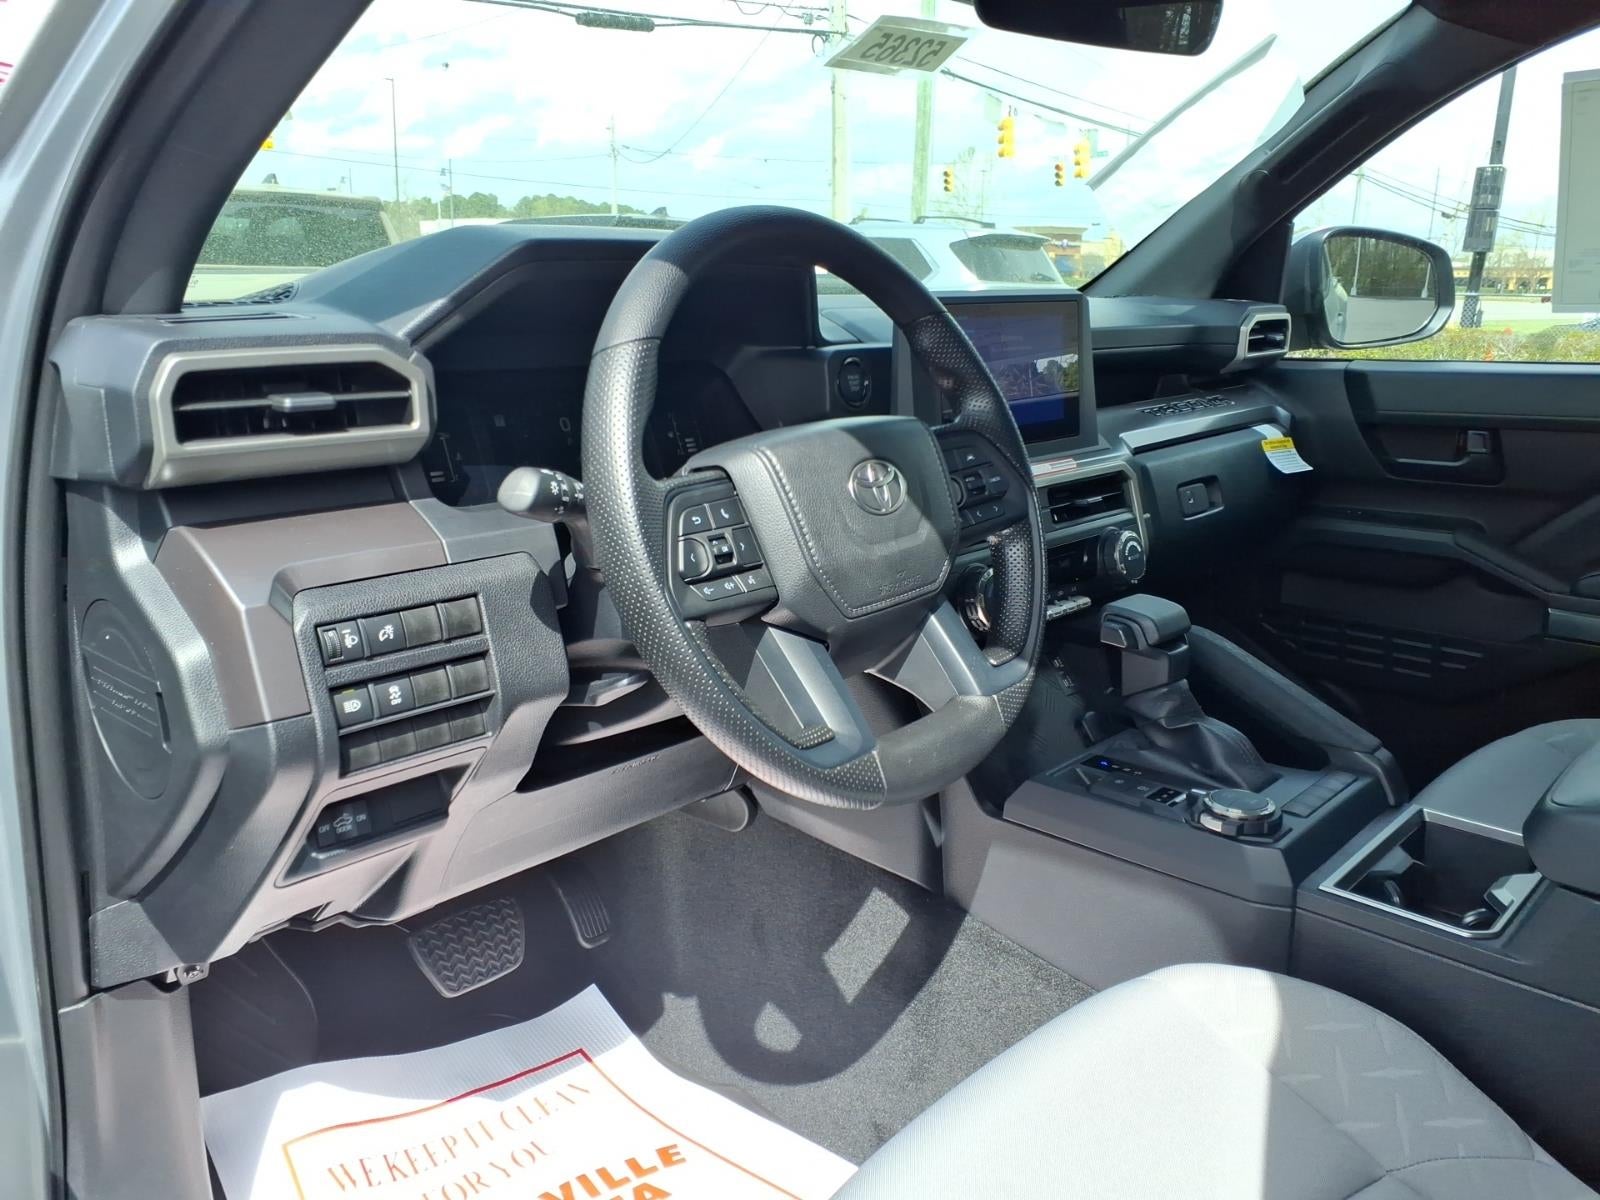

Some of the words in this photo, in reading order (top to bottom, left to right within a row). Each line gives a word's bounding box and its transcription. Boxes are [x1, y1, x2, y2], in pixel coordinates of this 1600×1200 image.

[327, 1158, 382, 1192] WE
[382, 1135, 457, 1182] KEEP
[489, 1141, 549, 1178] YOU
